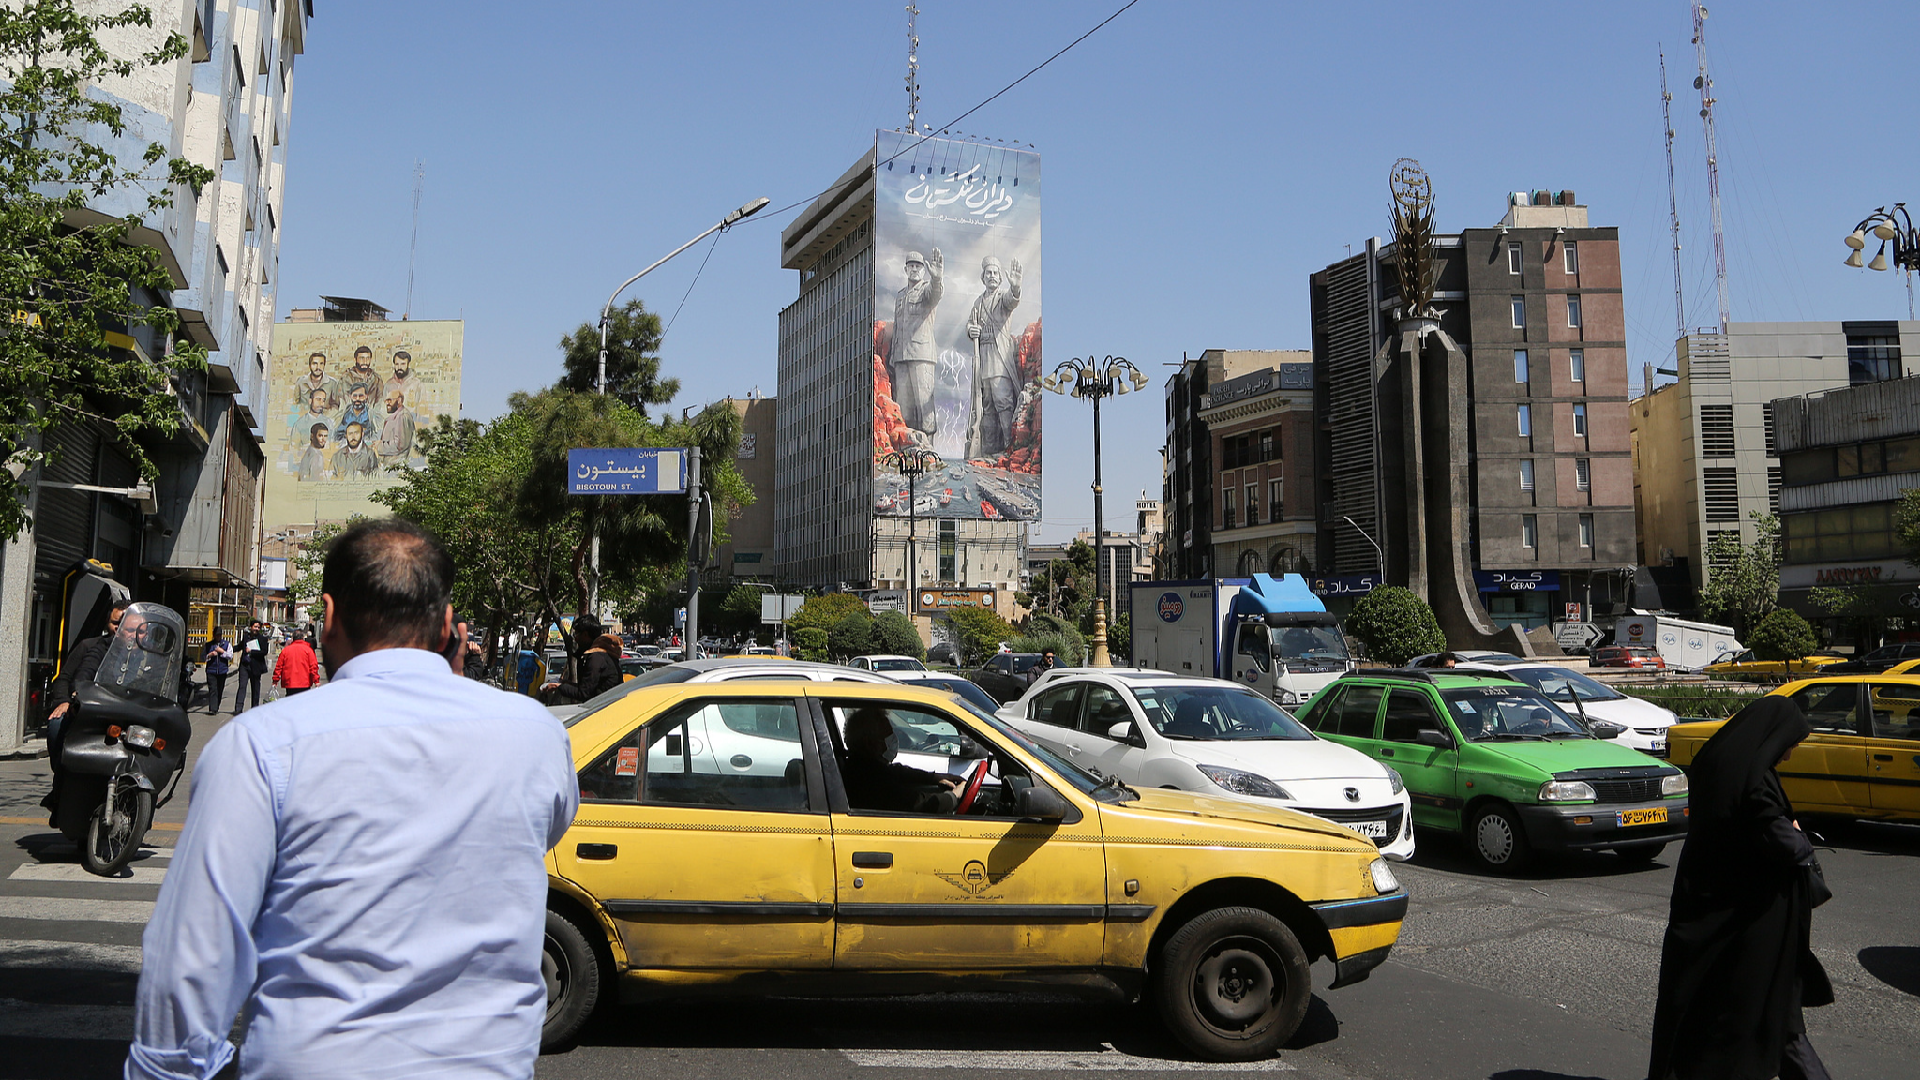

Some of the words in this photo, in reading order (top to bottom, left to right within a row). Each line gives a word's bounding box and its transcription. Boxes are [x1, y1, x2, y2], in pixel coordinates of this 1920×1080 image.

[638, 450, 658, 458] خیابان
[577, 460, 646, 480] بیستون
[1510, 582, 1536, 590] GERAD
